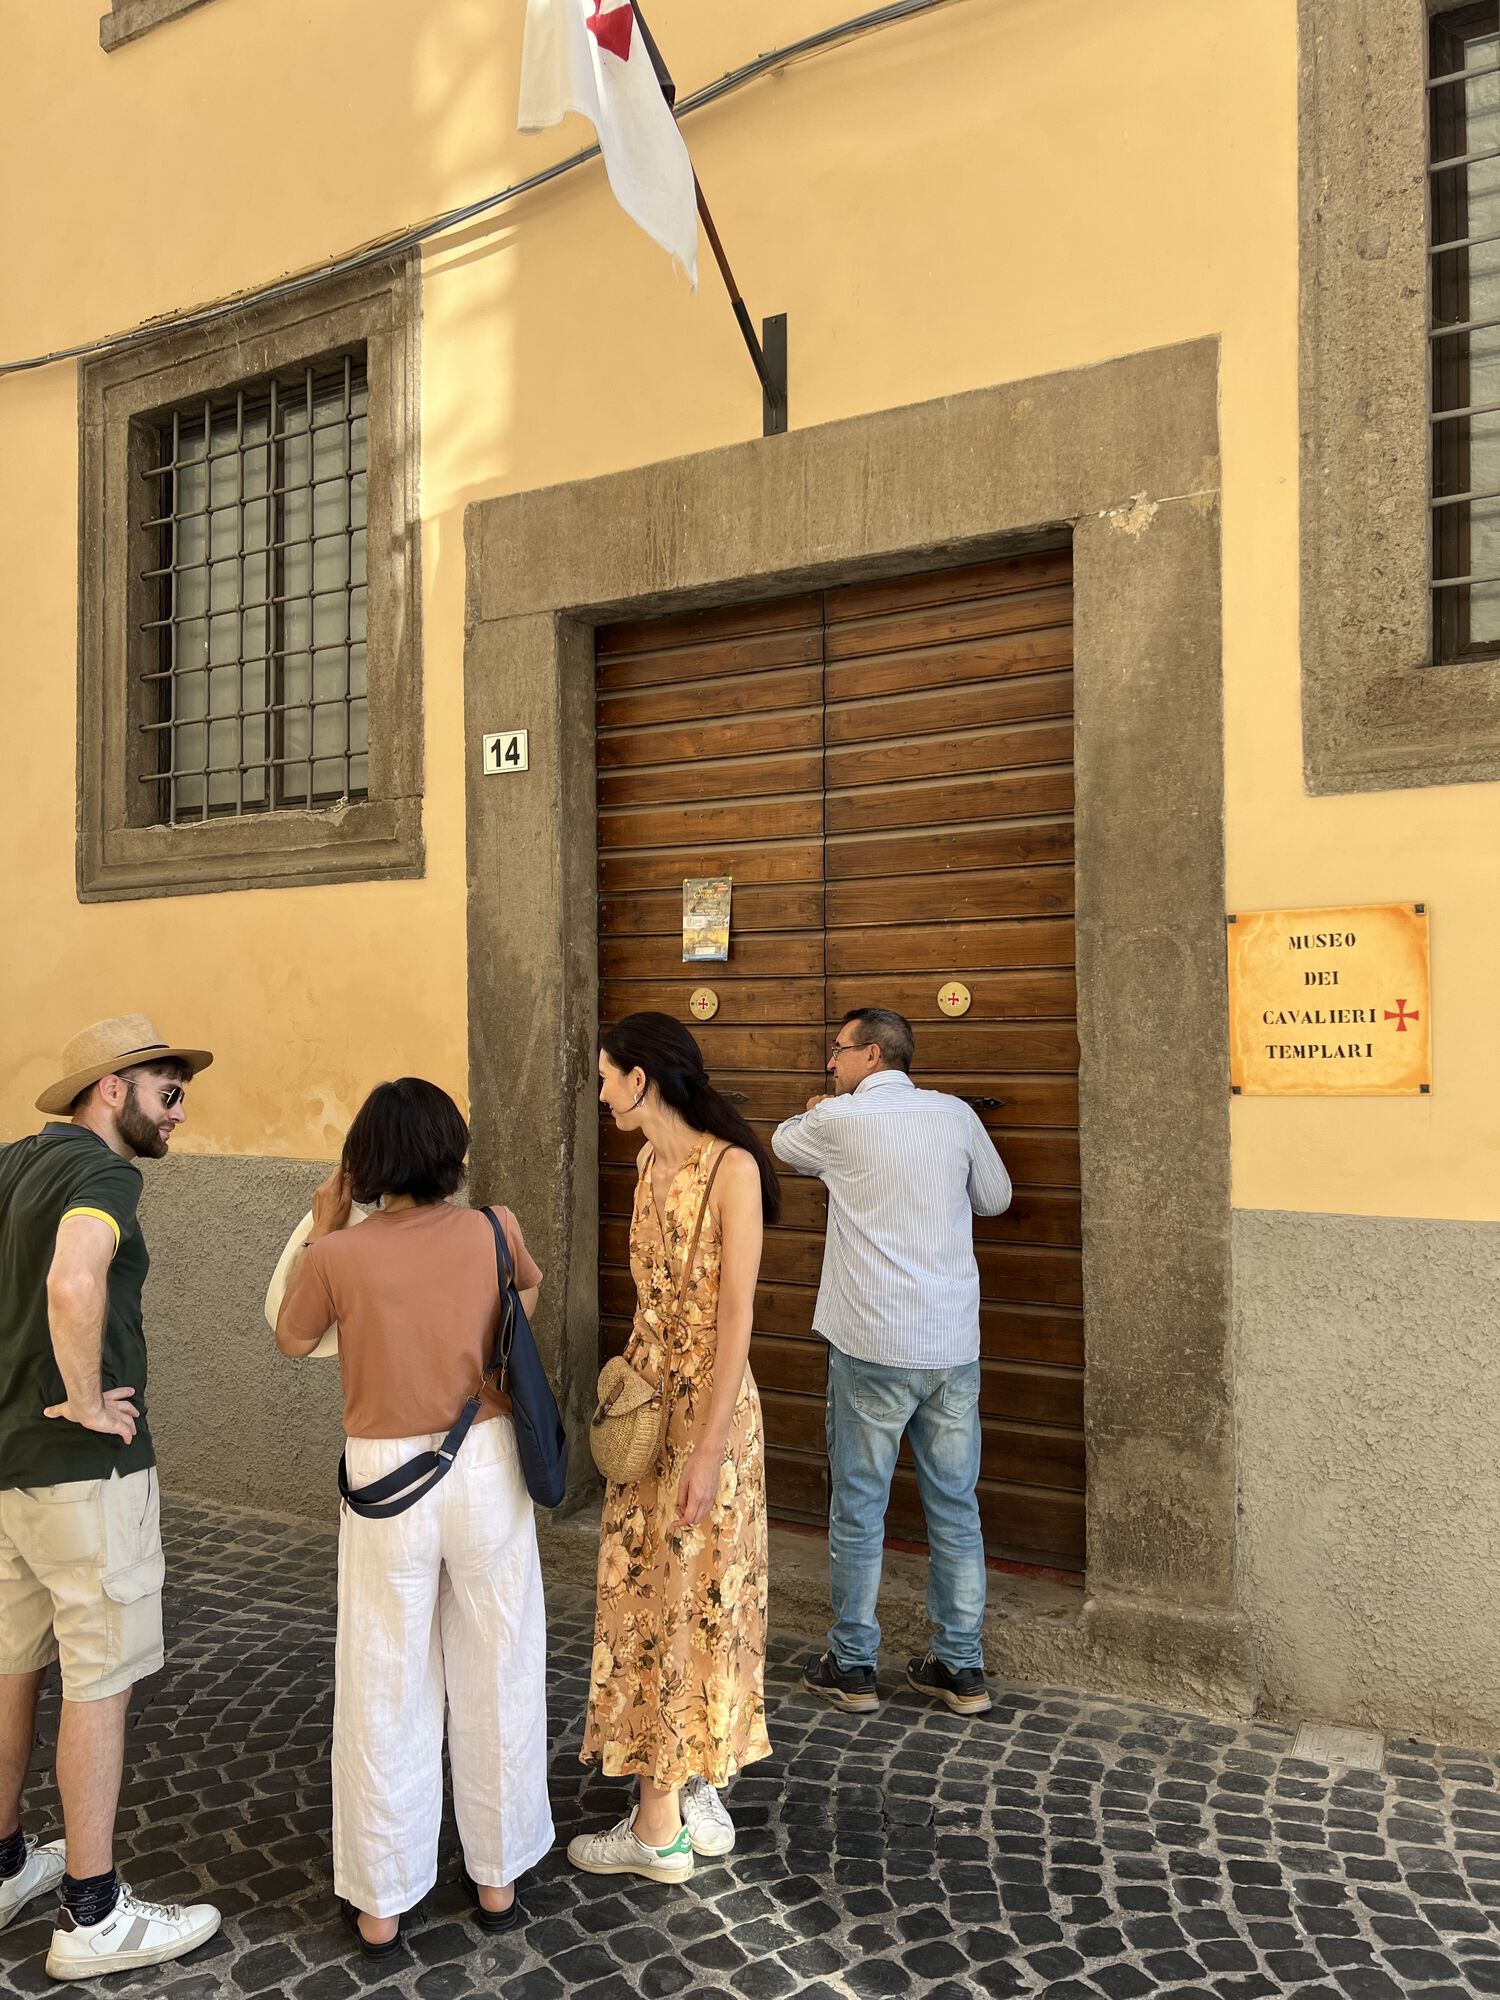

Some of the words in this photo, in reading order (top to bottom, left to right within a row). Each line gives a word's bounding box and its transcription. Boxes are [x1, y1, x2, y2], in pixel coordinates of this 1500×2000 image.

[491, 736, 520, 767] 14
[1289, 933, 1356, 950] MUSEO
[1304, 971, 1339, 985] DEI
[1262, 1009, 1376, 1025] CAVALIERI
[1265, 1044, 1373, 1059] TEMPLARI
